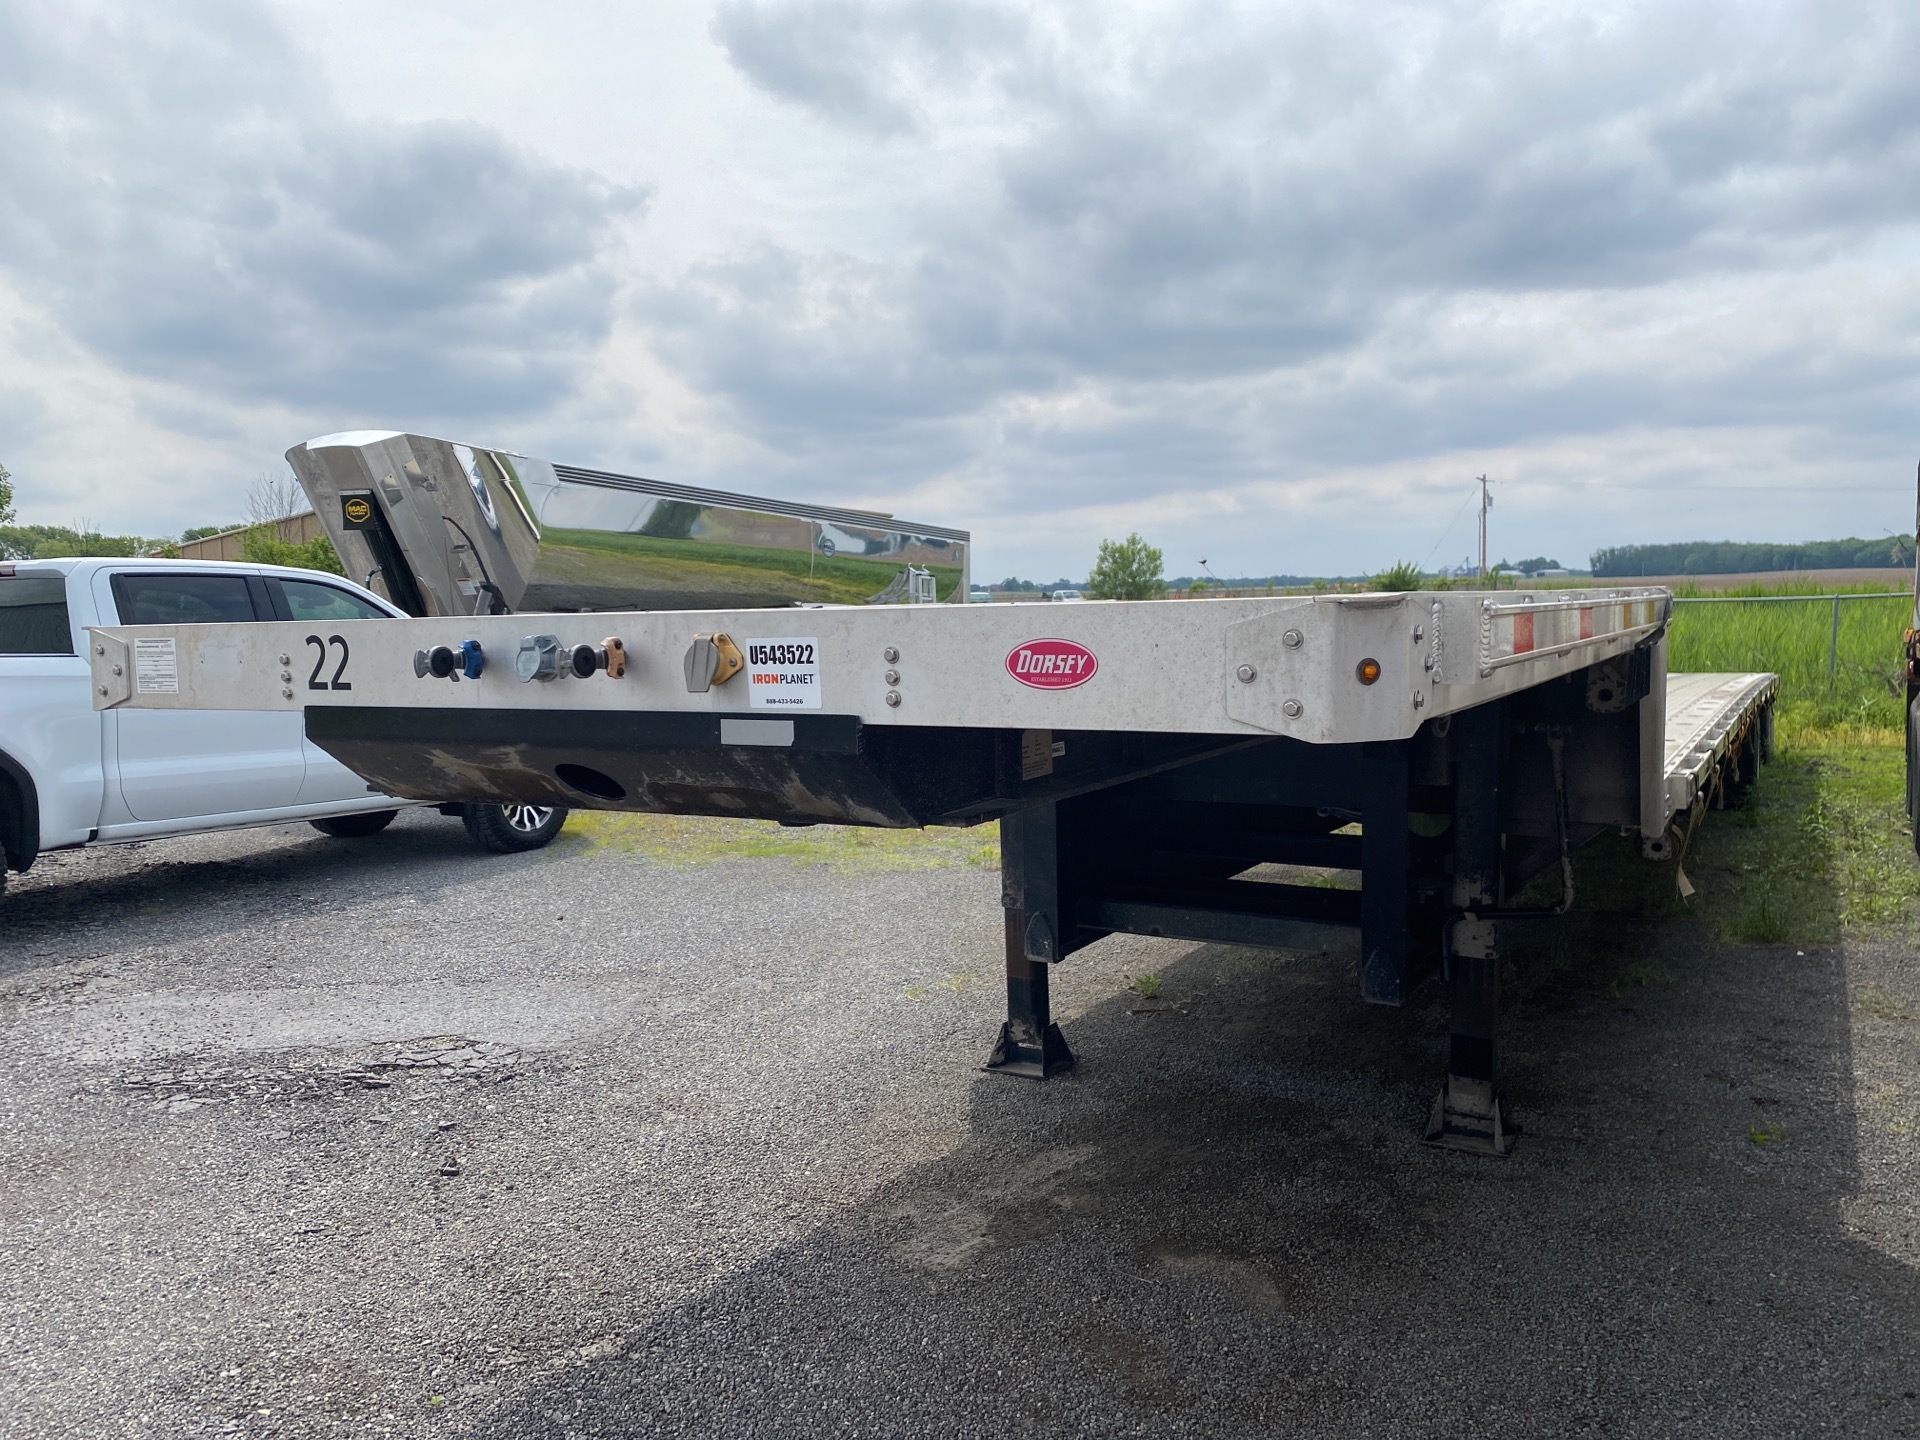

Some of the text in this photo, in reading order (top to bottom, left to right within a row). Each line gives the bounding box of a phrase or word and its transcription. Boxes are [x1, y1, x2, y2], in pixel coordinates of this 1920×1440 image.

[305, 635, 351, 690] 22
[749, 644, 814, 665] U543522
[1016, 650, 1088, 674] DORSEY
